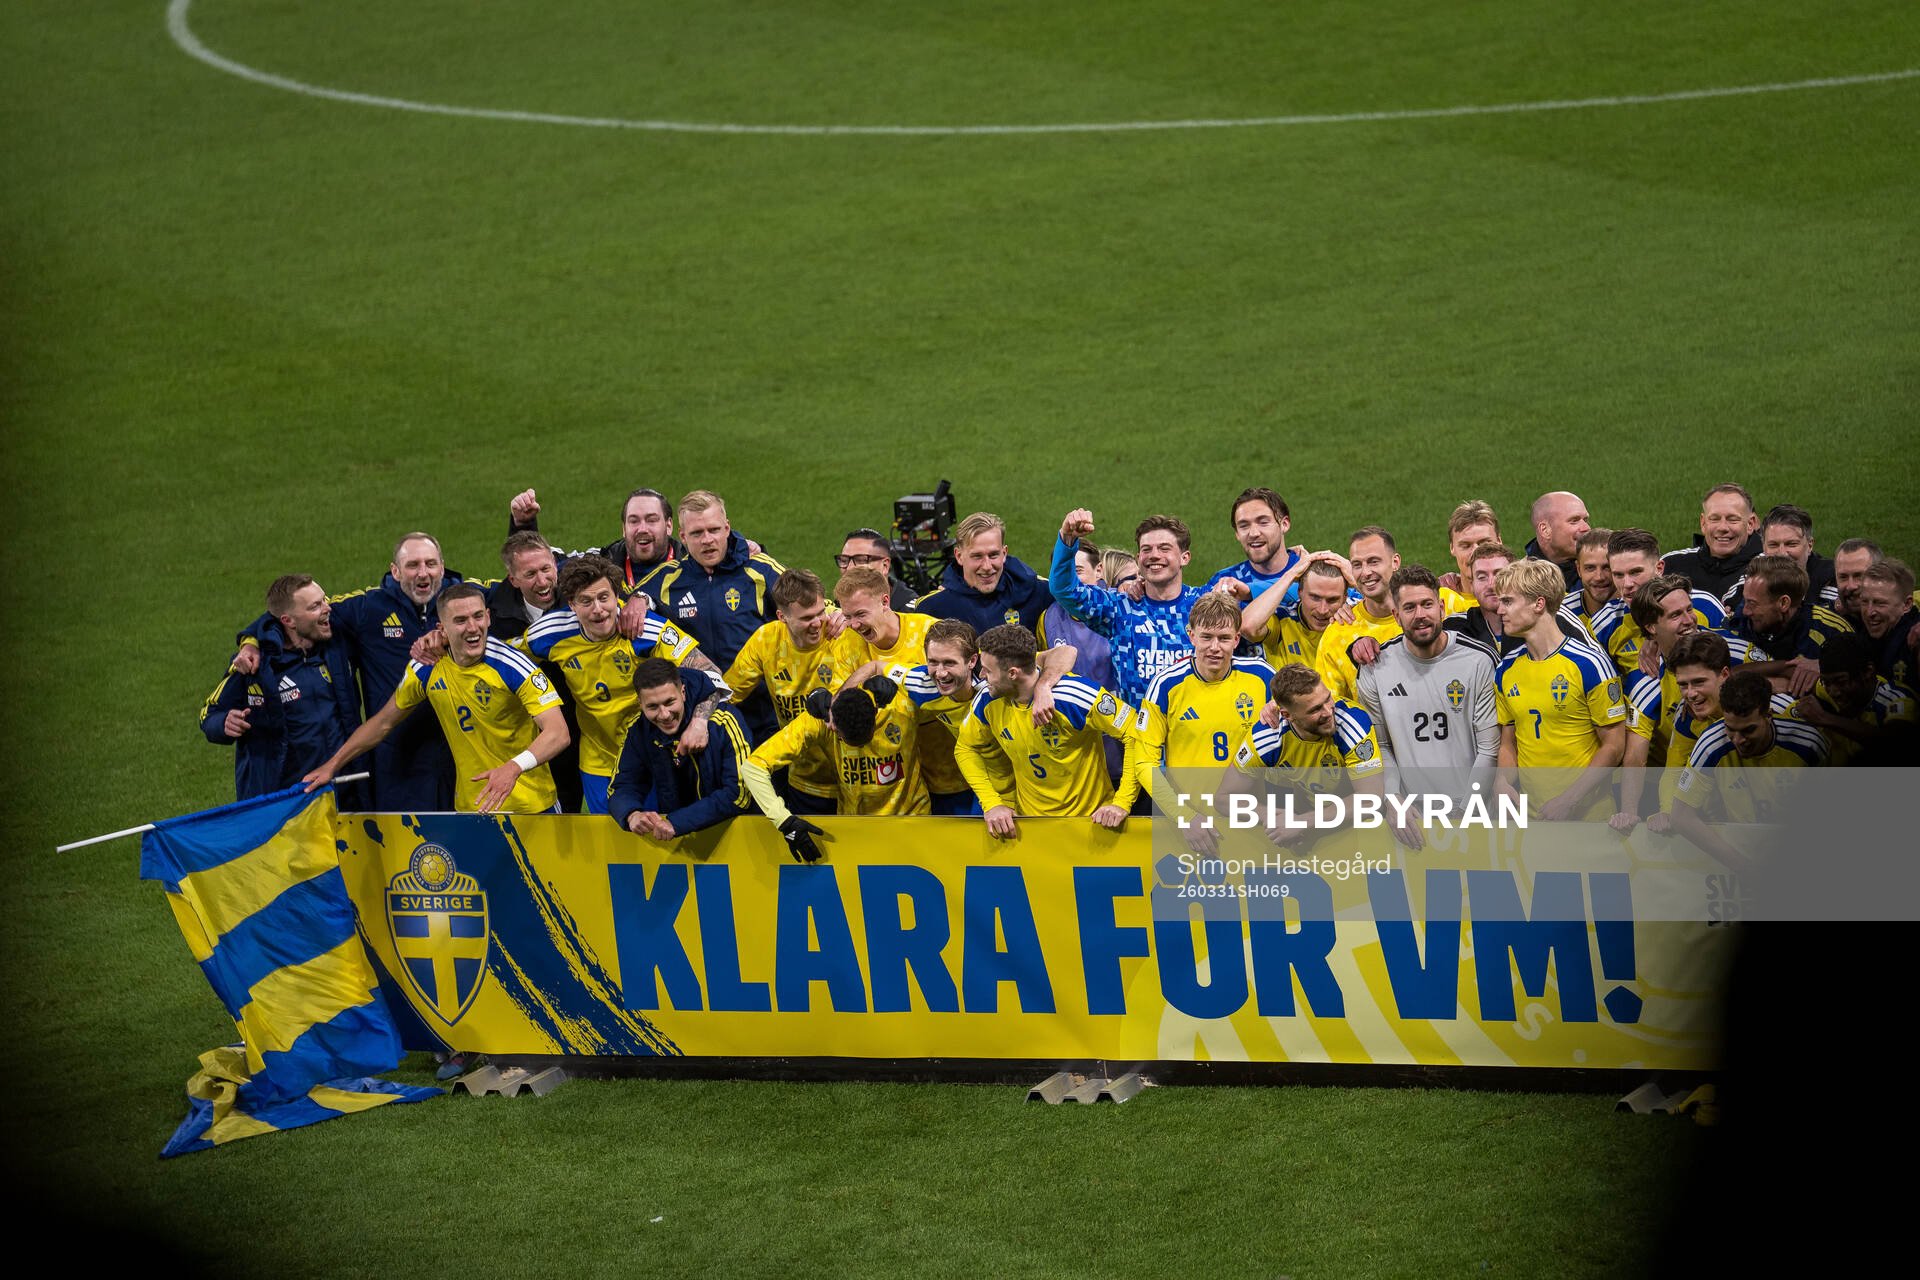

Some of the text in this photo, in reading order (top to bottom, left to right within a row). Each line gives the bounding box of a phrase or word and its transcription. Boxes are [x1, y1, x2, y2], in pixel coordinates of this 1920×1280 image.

[1138, 663, 1167, 680] SPE
[775, 694, 809, 710] SVEN
[457, 705, 474, 732] 2
[1413, 711, 1449, 742] 23
[1528, 709, 1542, 739] 7
[1212, 731, 1229, 762] 8
[843, 770, 876, 786] SPEL
[1028, 753, 1047, 779] 5
[400, 896, 473, 910] SVERIGE
[607, 855, 1643, 1024] KLARA FÖR VM!
